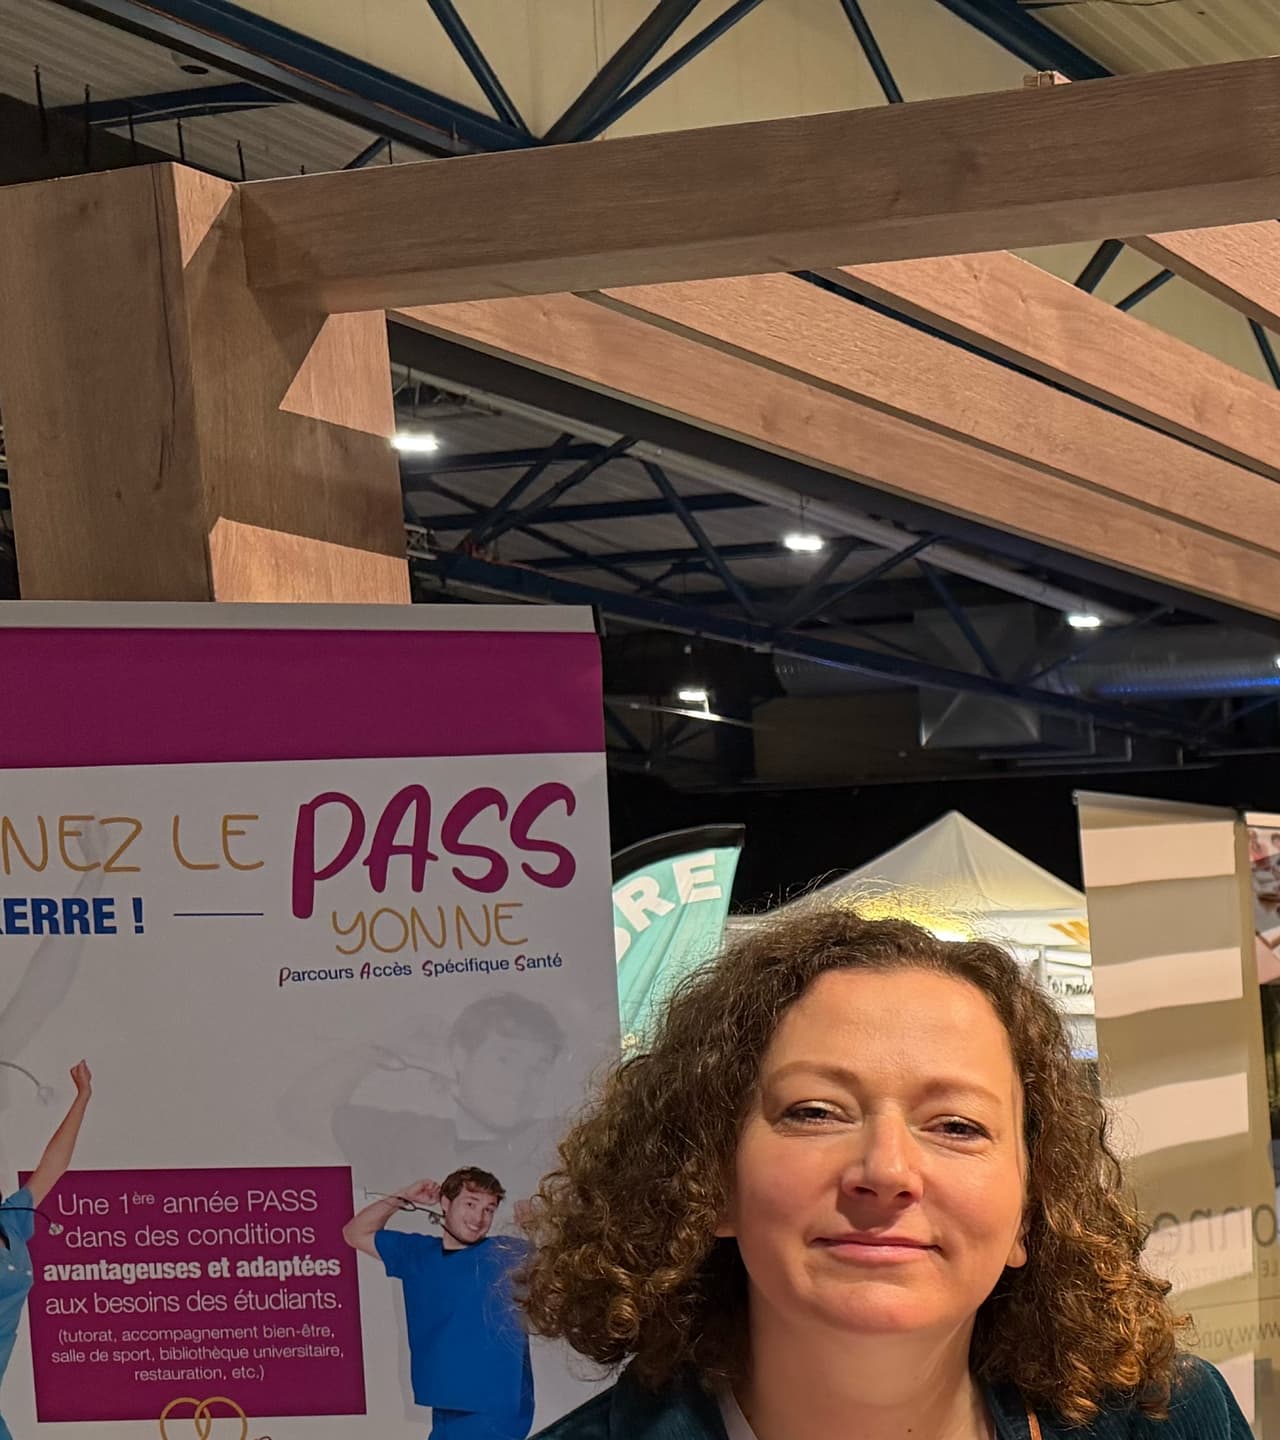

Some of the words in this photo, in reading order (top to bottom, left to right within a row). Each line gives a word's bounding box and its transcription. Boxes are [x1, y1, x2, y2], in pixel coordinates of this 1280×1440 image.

[1, 815, 143, 876] NEZ
[172, 813, 265, 871] LE
[291, 782, 577, 919] PASS
[0, 897, 117, 935] ERRE
[278, 966, 355, 988] Parcours
[360, 960, 412, 981] Accès
[421, 955, 510, 979] Spécifique
[515, 952, 563, 973] Santé
[58, 1193, 109, 1217] Une
[163, 1191, 239, 1214] année
[247, 1189, 318, 1214] PASS
[65, 1227, 127, 1248] dans
[135, 1225, 180, 1247] des
[187, 1223, 315, 1246] conditions
[43, 1259, 202, 1285] avantageuses
[208, 1258, 232, 1280] et
[236, 1254, 341, 1281] adaptées
[46, 1298, 88, 1315] aux
[94, 1292, 180, 1314] besoins
[186, 1291, 228, 1312] des
[234, 1289, 343, 1311] étudiants.
[121, 1327, 258, 1344] accompagnement
[51, 1349, 86, 1364] salle
[89, 1348, 109, 1362] de
[112, 1348, 155, 1365] sport,
[159, 1346, 249, 1365] bibliothèque
[134, 1367, 226, 1382] restauration,
